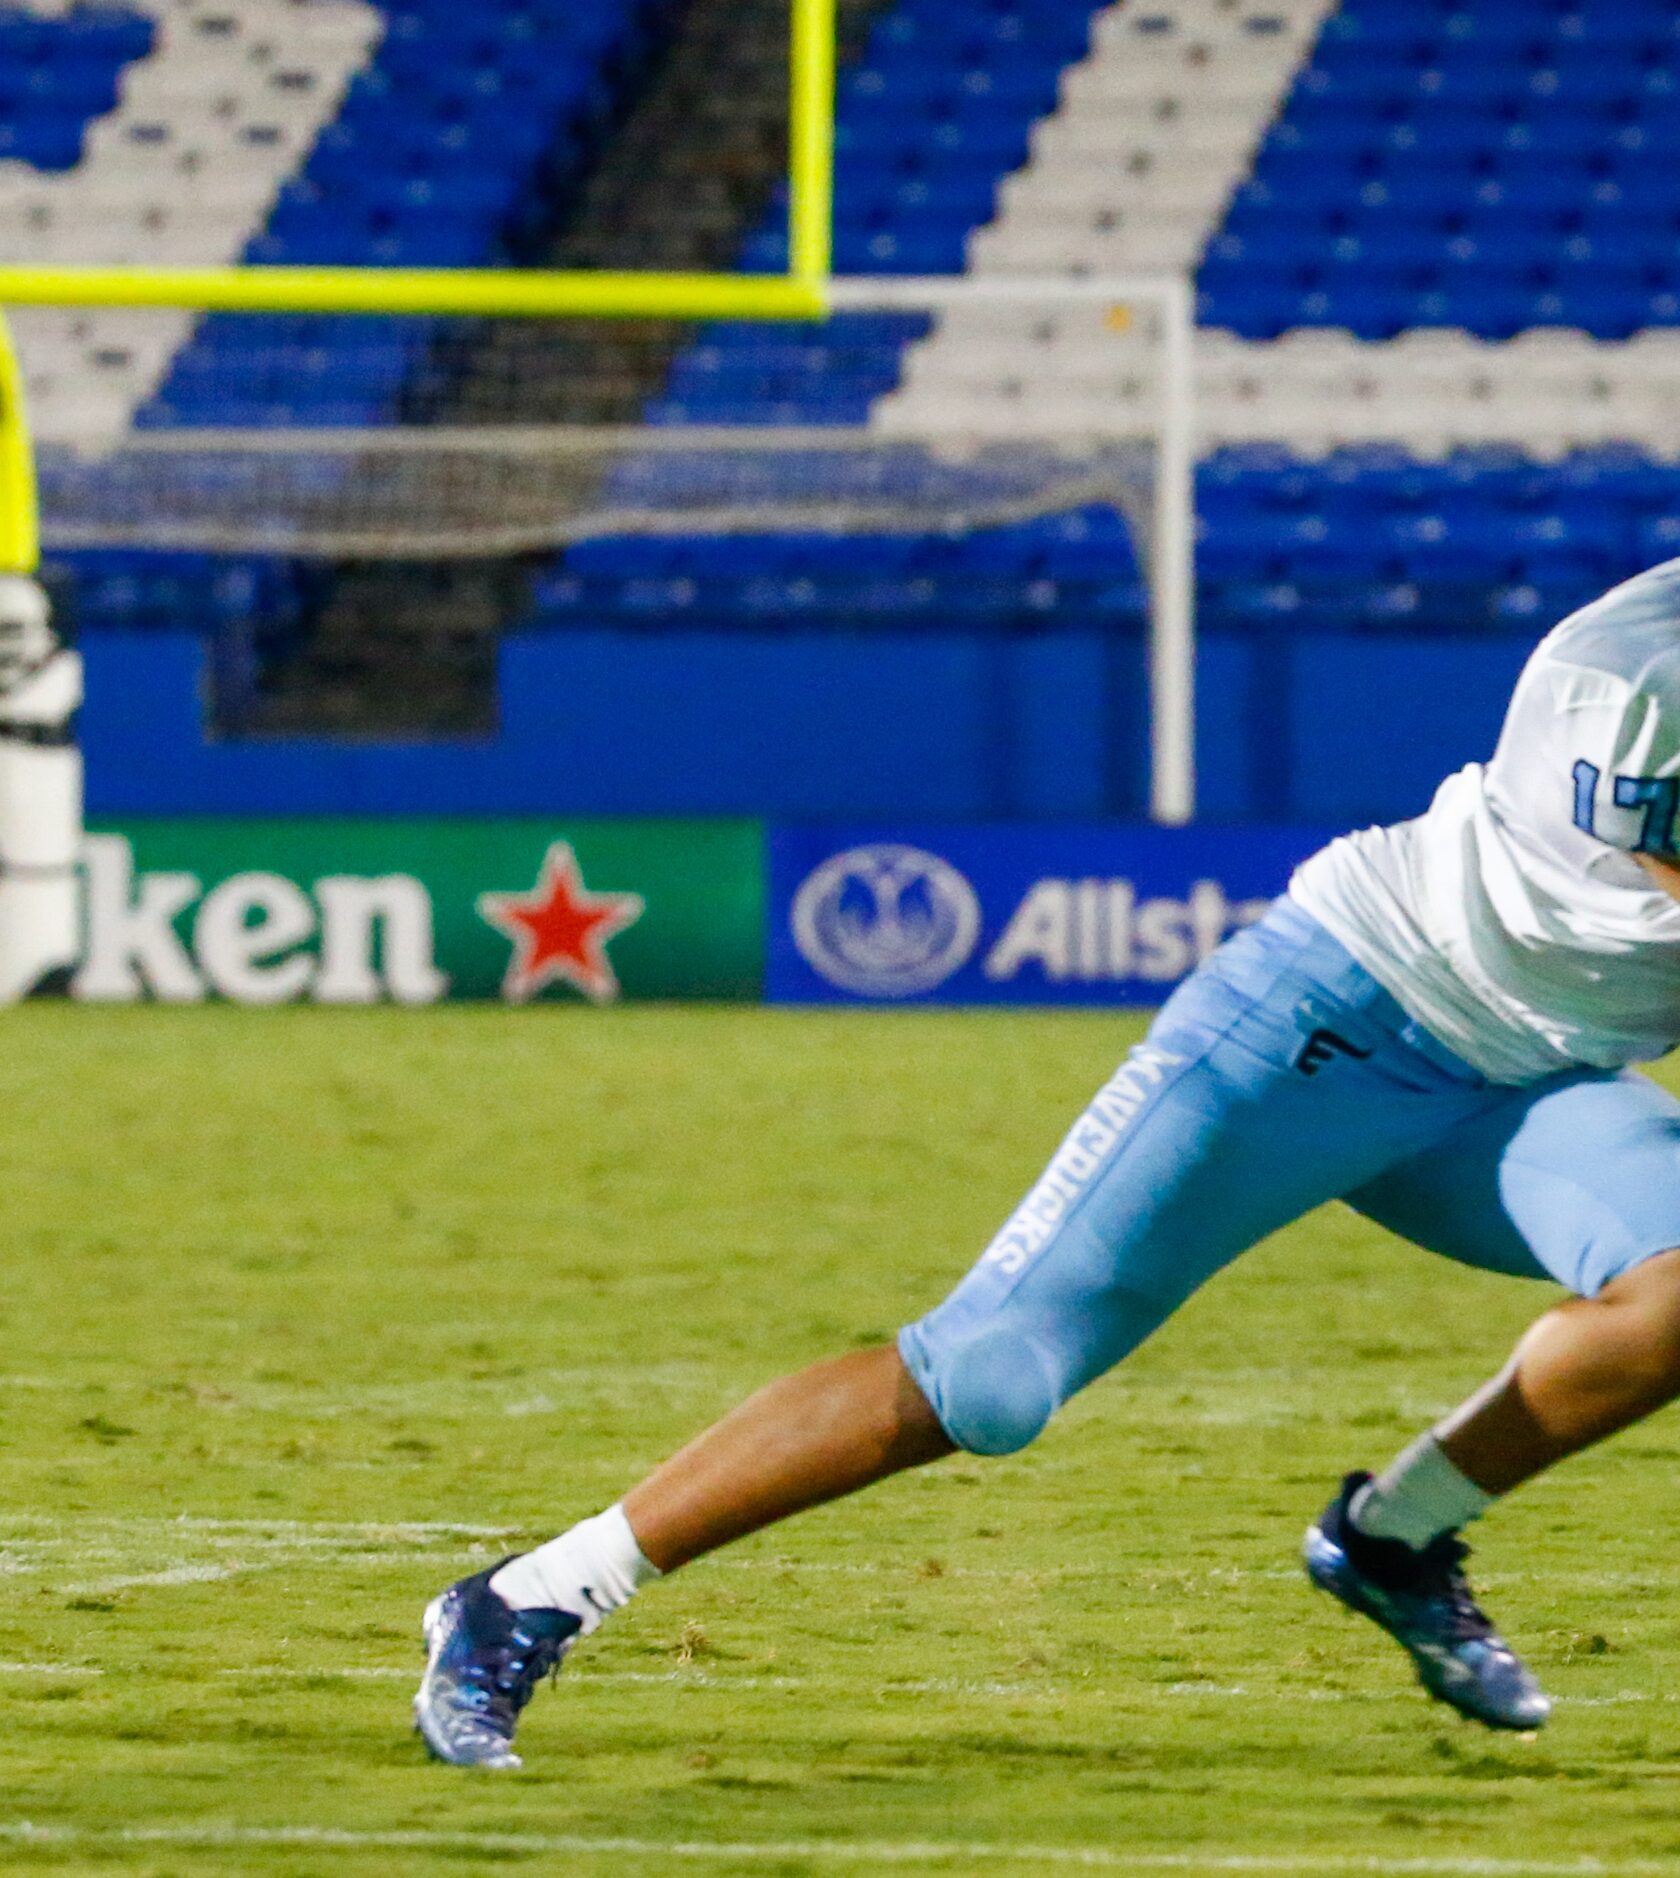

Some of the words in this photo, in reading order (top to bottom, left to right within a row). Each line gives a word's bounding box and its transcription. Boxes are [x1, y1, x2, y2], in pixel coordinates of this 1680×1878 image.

[1571, 758, 1680, 855] 17
[75, 831, 448, 1002] ken
[985, 877, 1274, 982] Allst
[985, 1044, 1184, 1275] MAVERICKS
